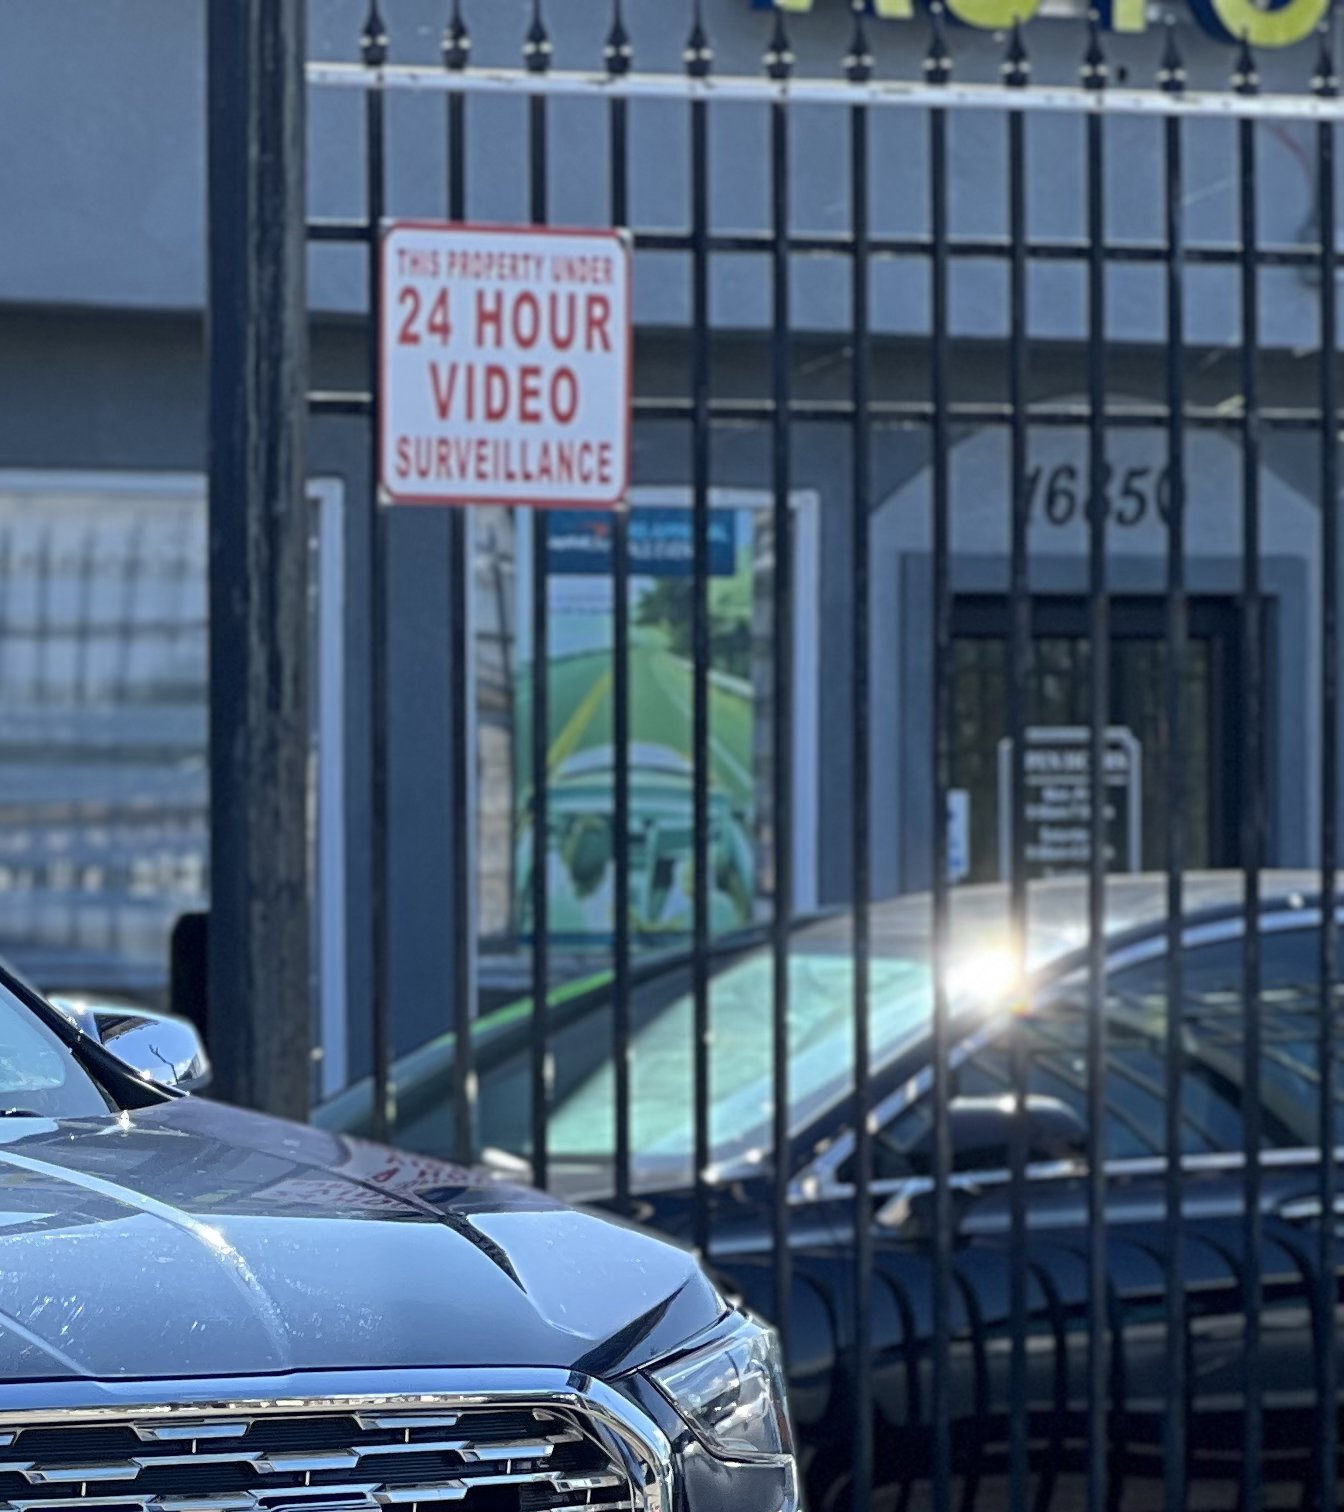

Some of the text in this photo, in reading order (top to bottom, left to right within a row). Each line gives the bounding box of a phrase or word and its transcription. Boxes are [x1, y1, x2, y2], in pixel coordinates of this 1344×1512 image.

[397, 248, 614, 285] THIS PROPERTY UNDER
[397, 286, 612, 352] 24 HOUR
[429, 361, 579, 424] VIDEO
[395, 435, 612, 484] SURVEILLANCE
